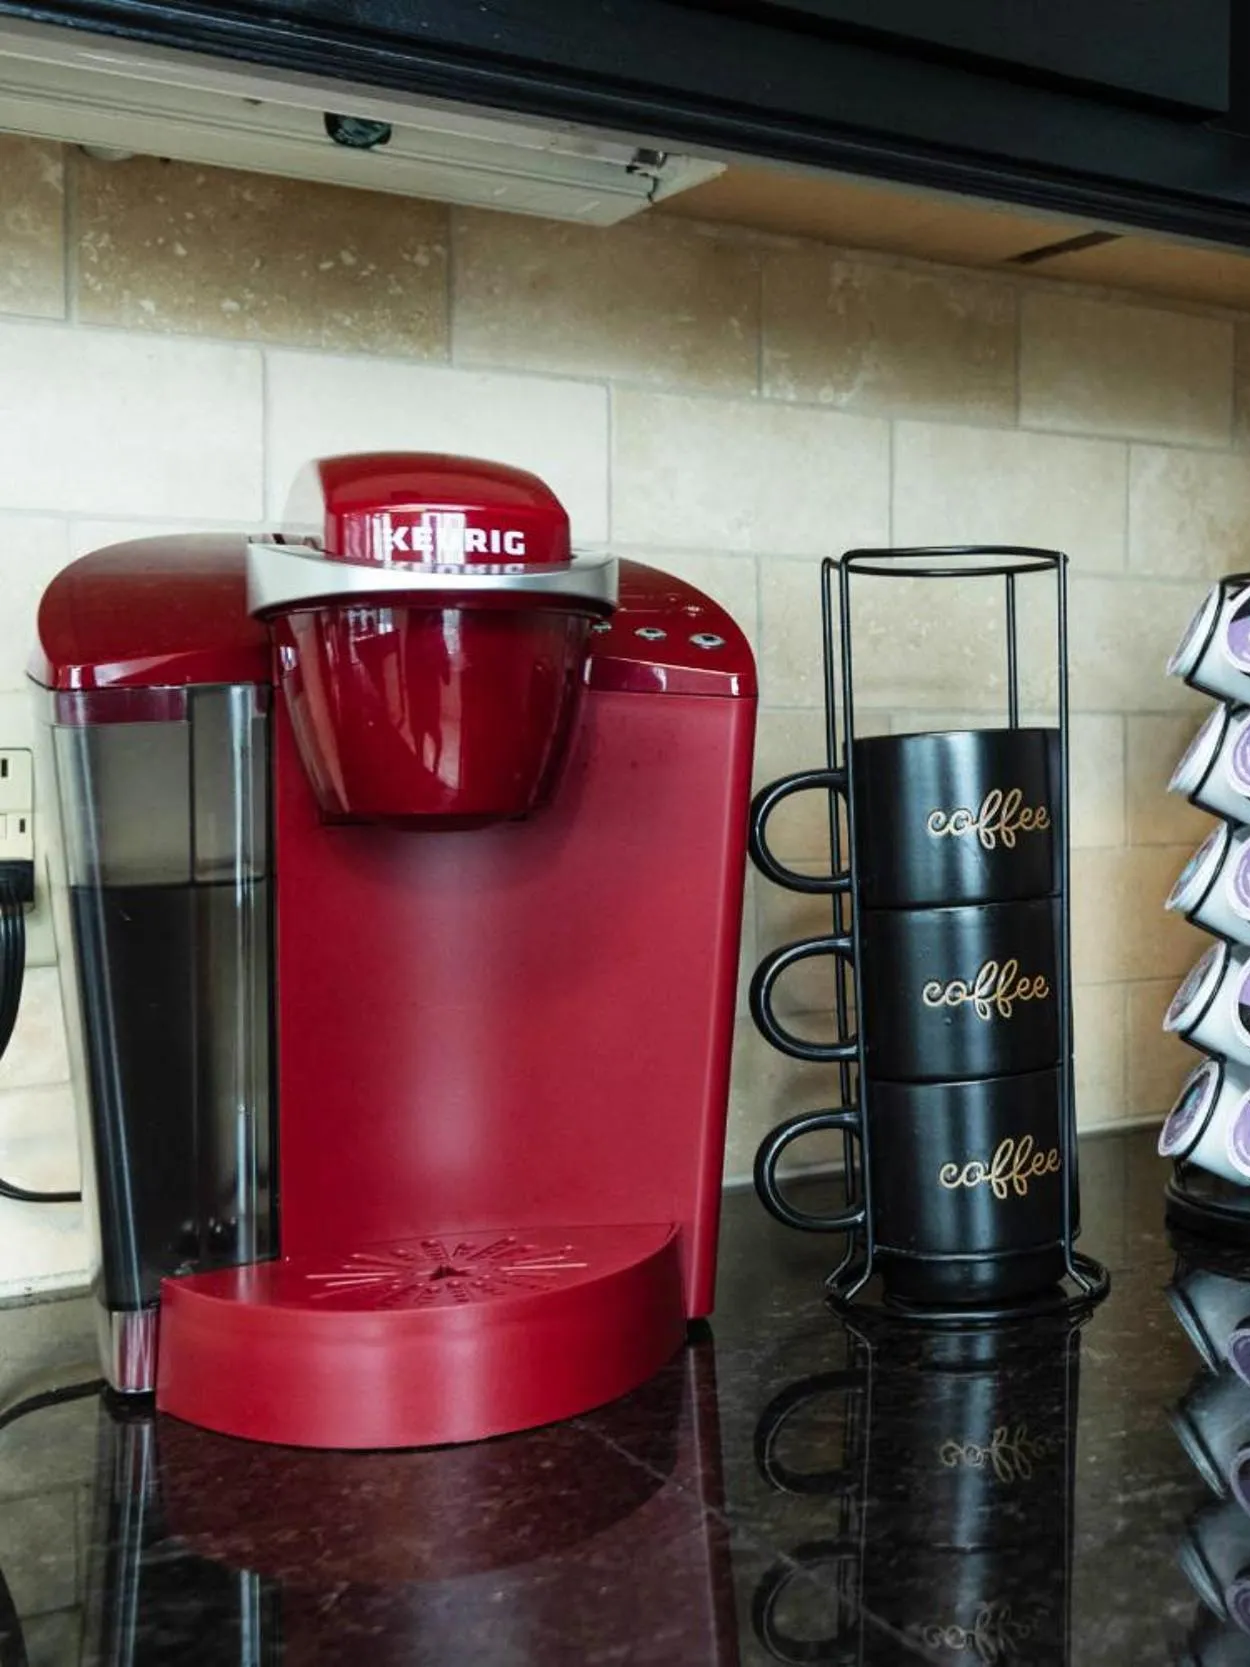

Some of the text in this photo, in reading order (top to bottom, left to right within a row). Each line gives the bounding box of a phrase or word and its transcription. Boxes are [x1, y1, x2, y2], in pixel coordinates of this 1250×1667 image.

[384, 526, 526, 556] KERIG
[927, 788, 1050, 849] coffee
[923, 959, 1049, 1020] coffee
[939, 1134, 1061, 1199] coffee
